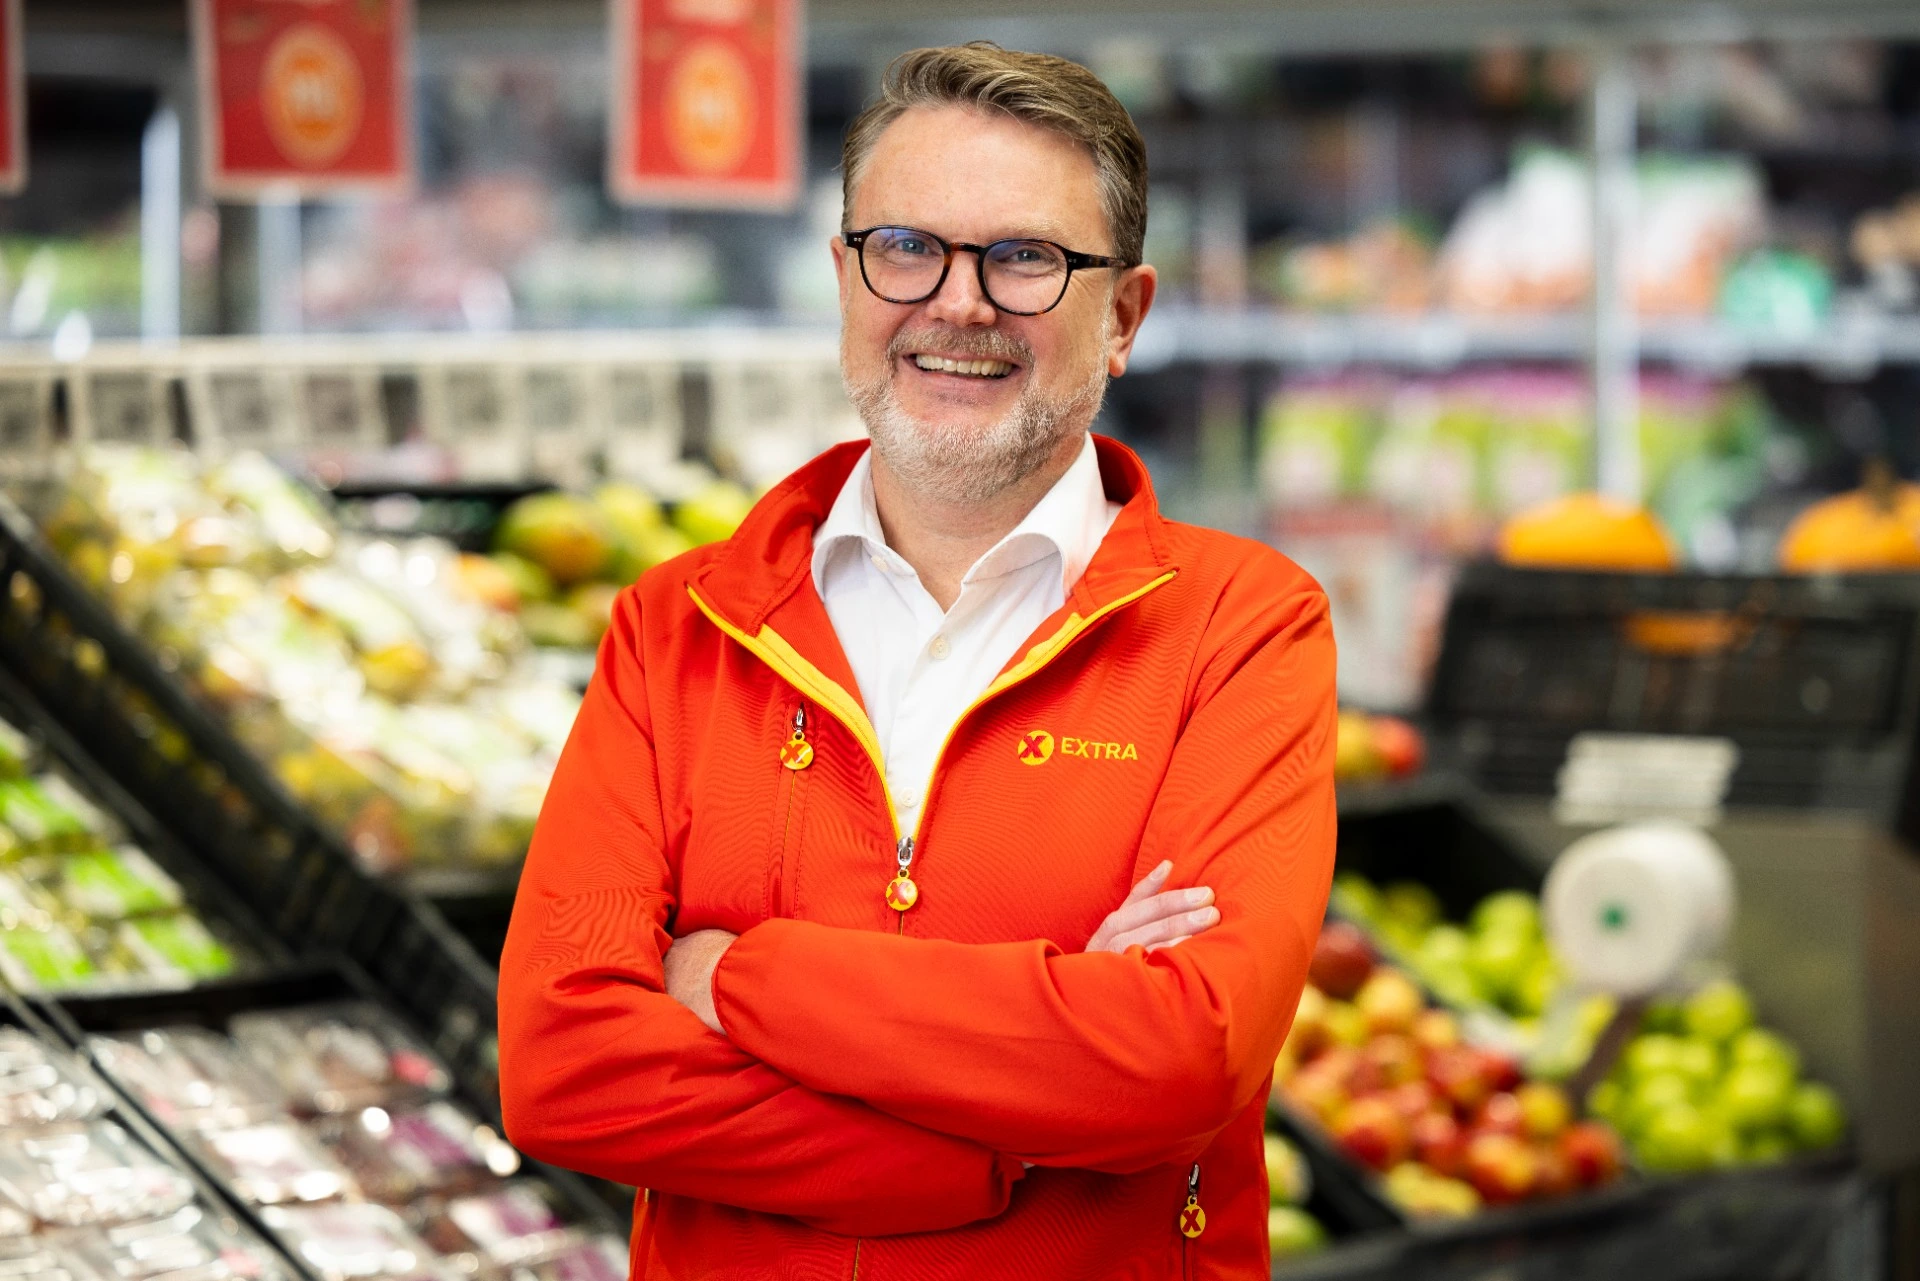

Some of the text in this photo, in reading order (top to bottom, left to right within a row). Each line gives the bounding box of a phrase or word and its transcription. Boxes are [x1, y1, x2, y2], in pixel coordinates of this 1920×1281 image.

[1019, 735, 1138, 760] X EXTRA
[1182, 1208, 1201, 1233] X
